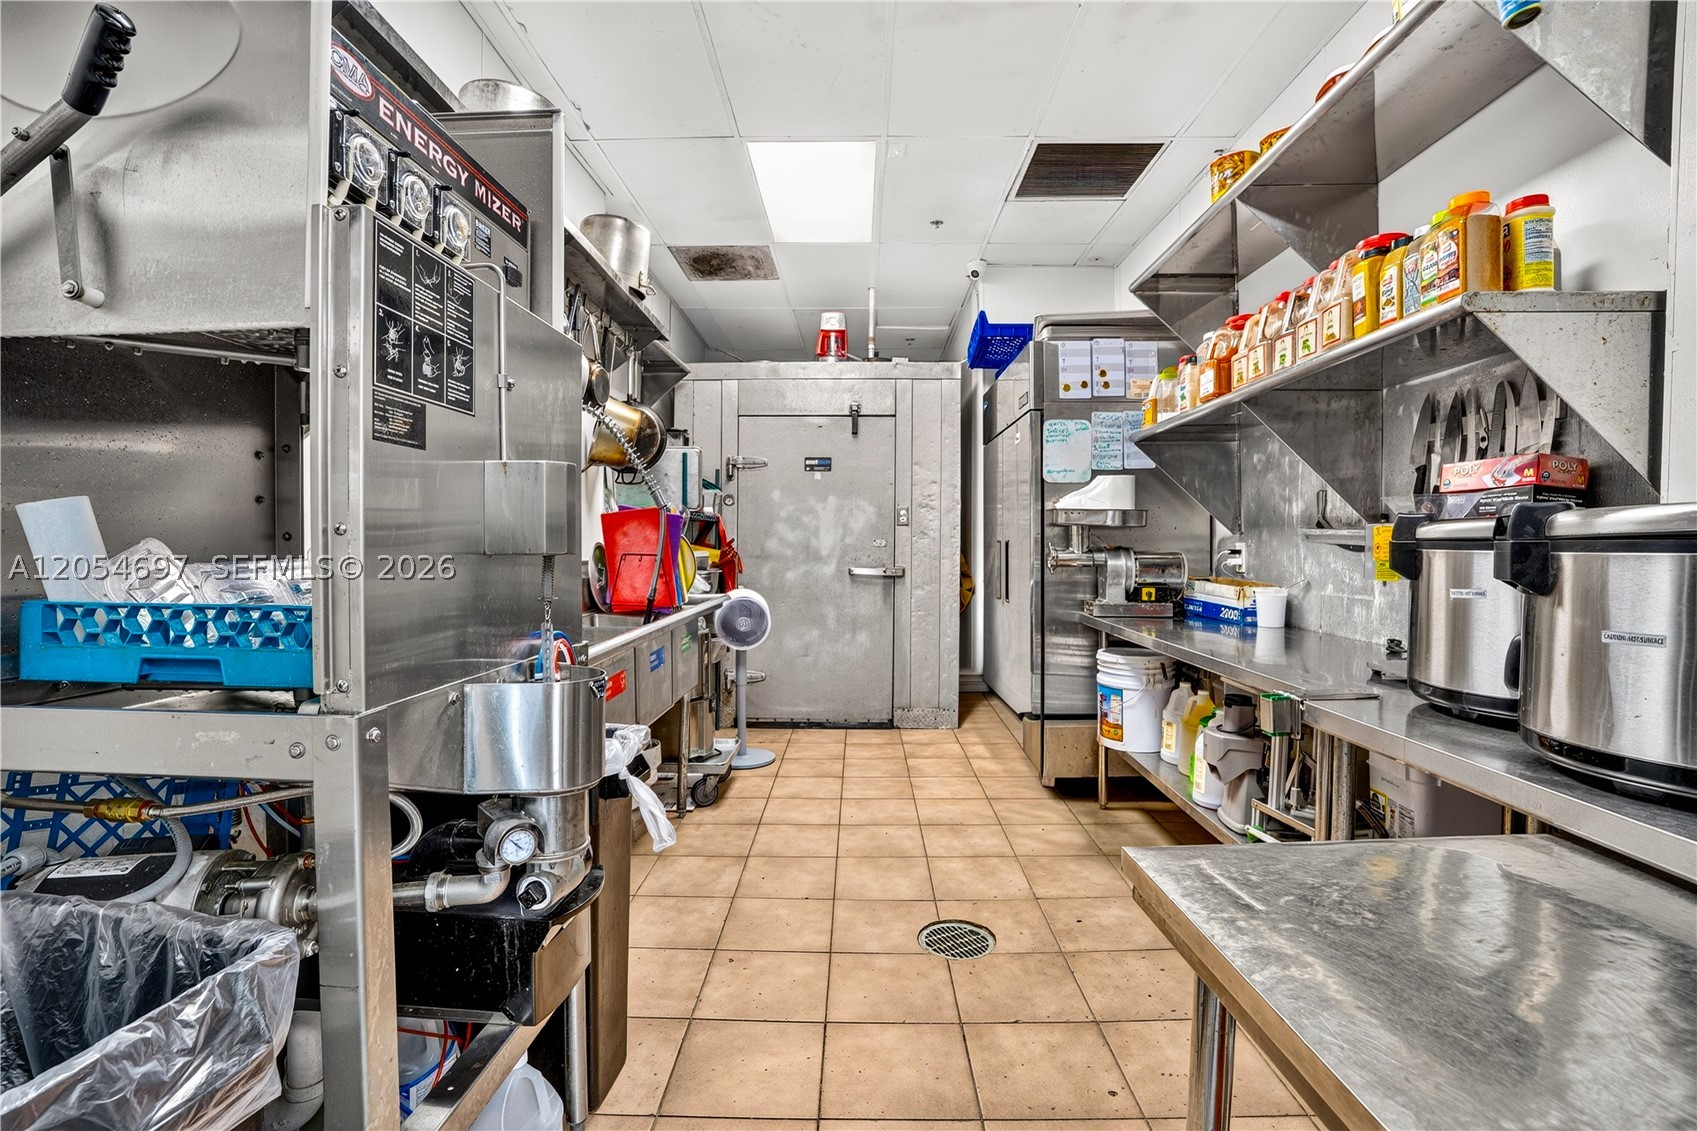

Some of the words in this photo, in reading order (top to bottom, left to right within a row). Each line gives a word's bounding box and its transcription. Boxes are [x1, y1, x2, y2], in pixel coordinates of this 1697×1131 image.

[378, 96, 469, 187] ENERGY
[474, 178, 523, 233] MIZER
[1453, 464, 1481, 476] POLY
[1552, 459, 1578, 473] POLY
